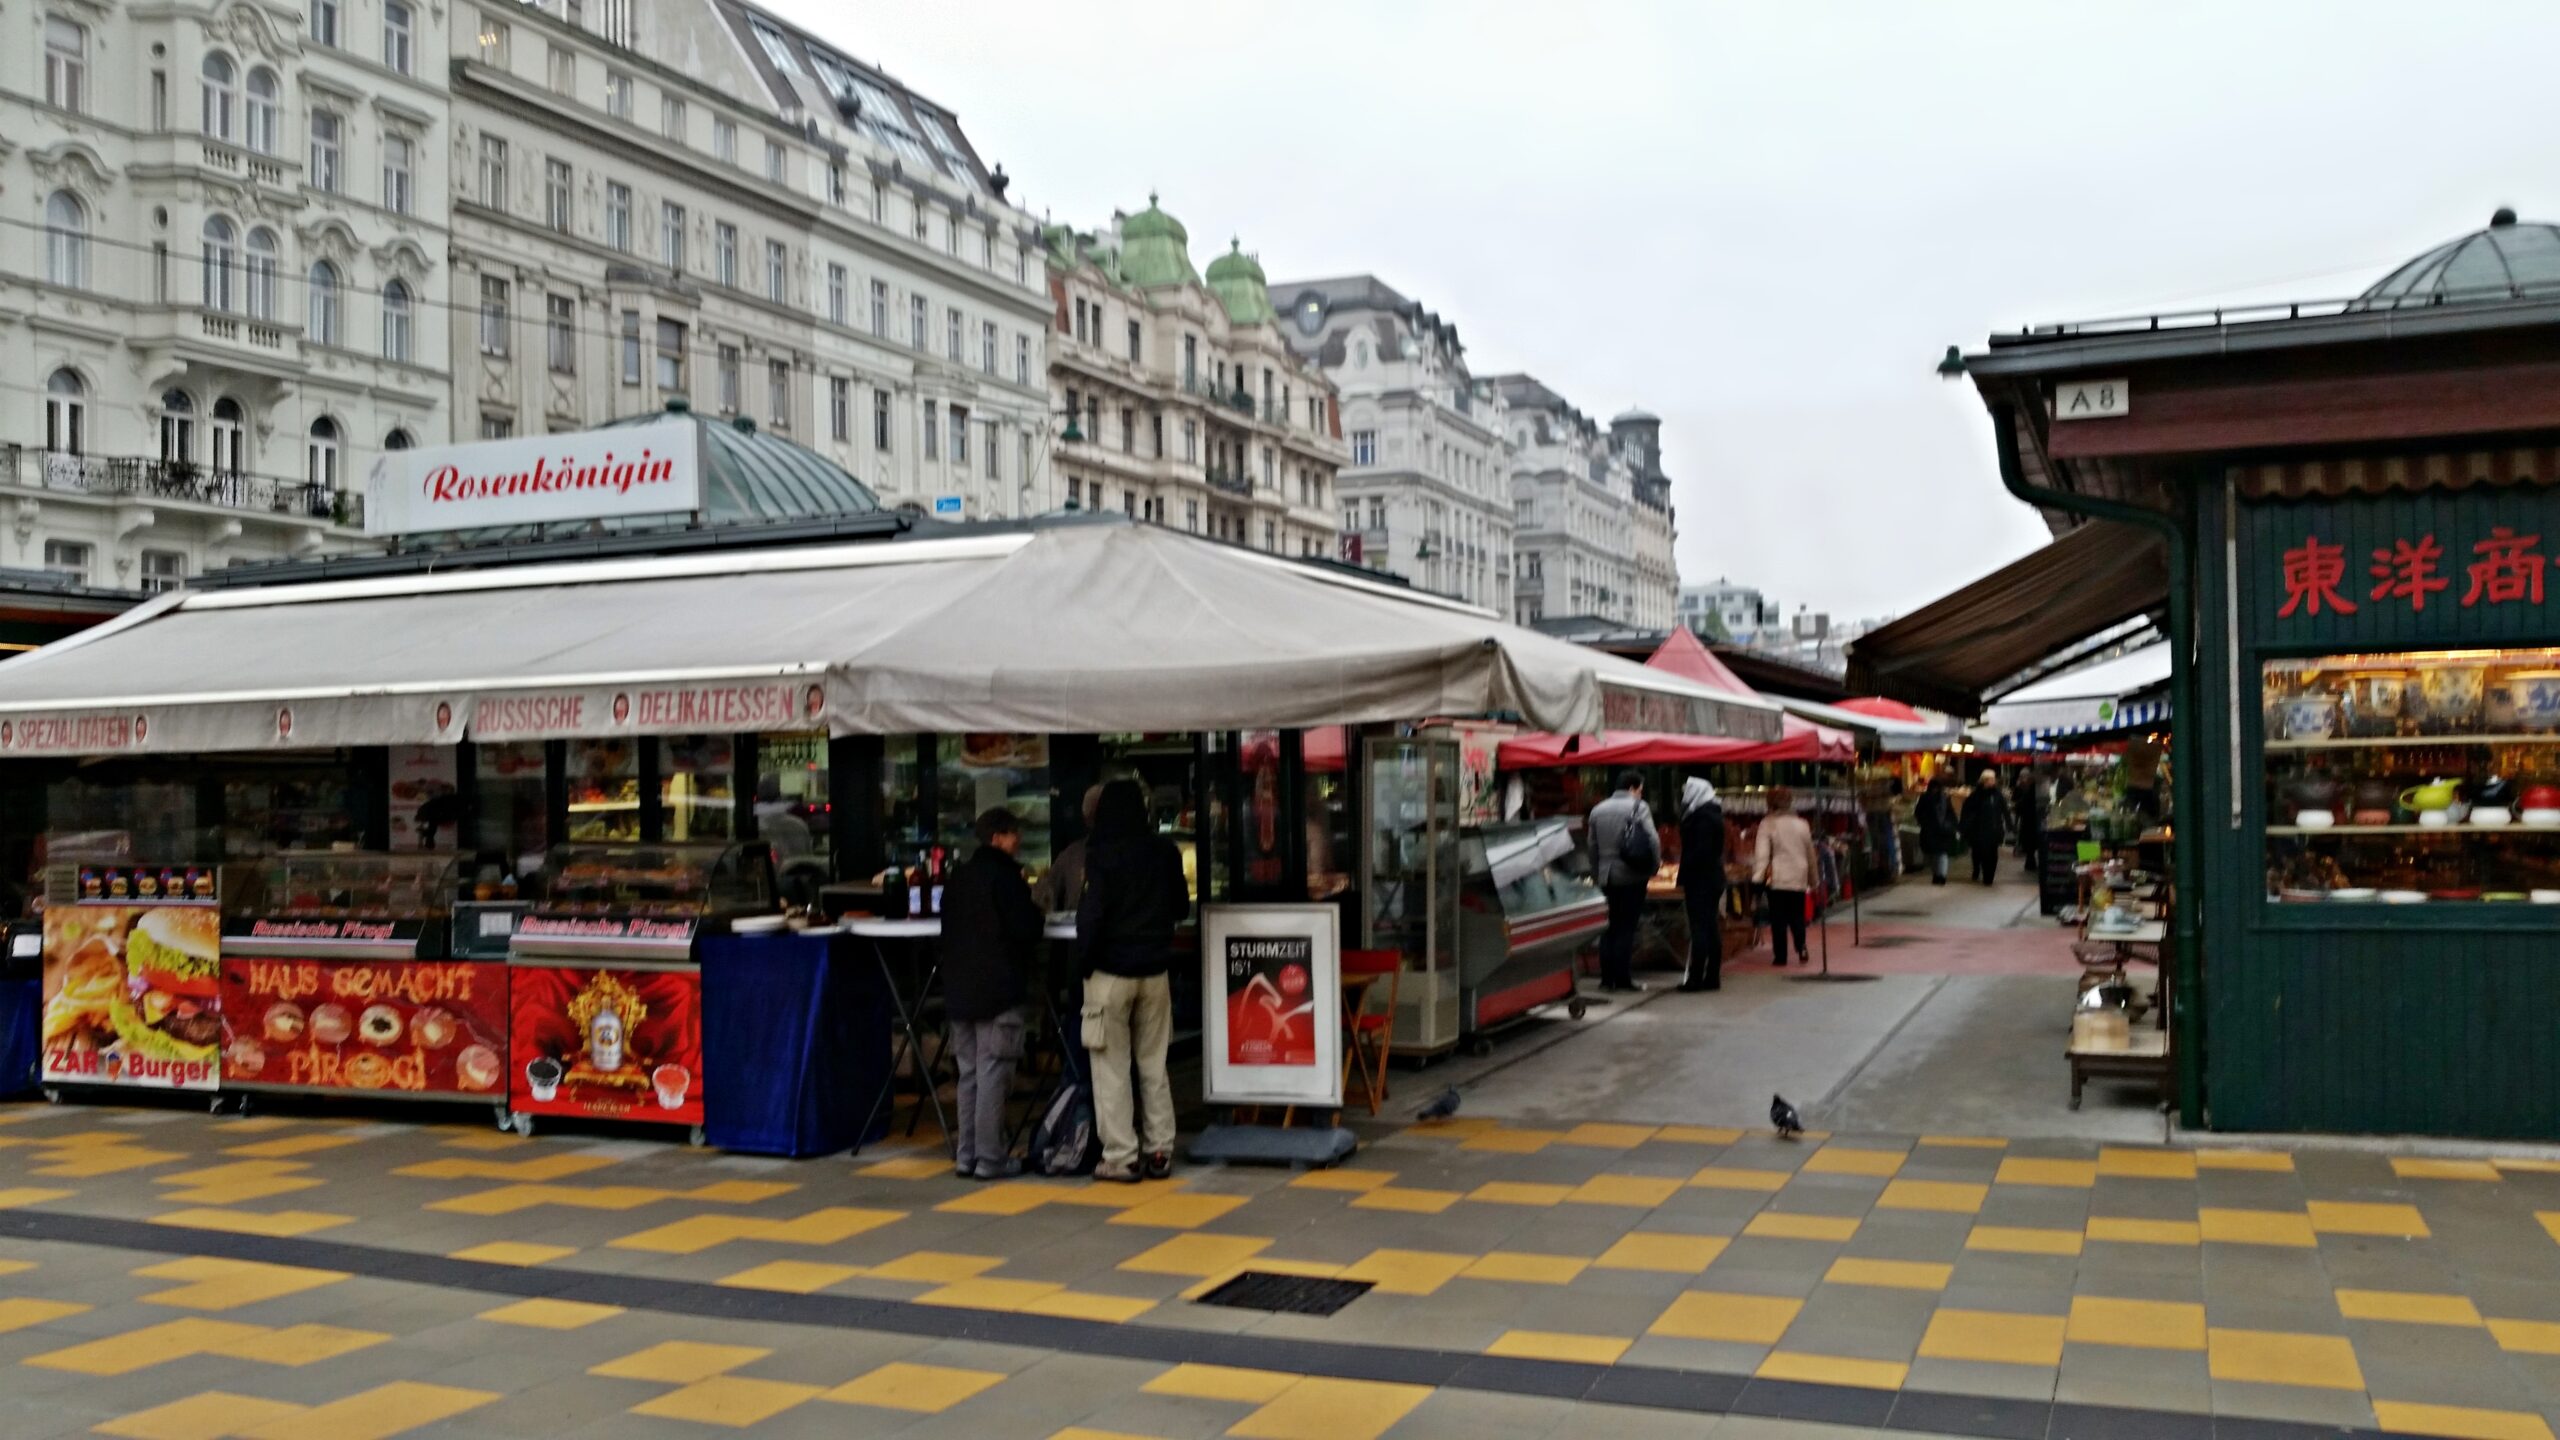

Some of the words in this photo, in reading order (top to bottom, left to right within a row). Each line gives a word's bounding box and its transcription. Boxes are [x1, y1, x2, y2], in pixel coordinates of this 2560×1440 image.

[424, 449, 673, 502] Rosenkönigin
[2277, 526, 2560, 618] 東洋商
[476, 695, 585, 733] RUSSISCHE
[638, 687, 794, 725] DELIKATESSEN
[251, 918, 340, 938] Russische
[340, 919, 396, 943] Pirogi
[519, 914, 624, 937] Russische
[627, 916, 692, 942] Pirogi
[1229, 940, 1309, 959] STURMZEIT
[249, 959, 320, 1000] HAUS
[49, 1050, 99, 1073] ZAR
[128, 1052, 213, 1087] Burger
